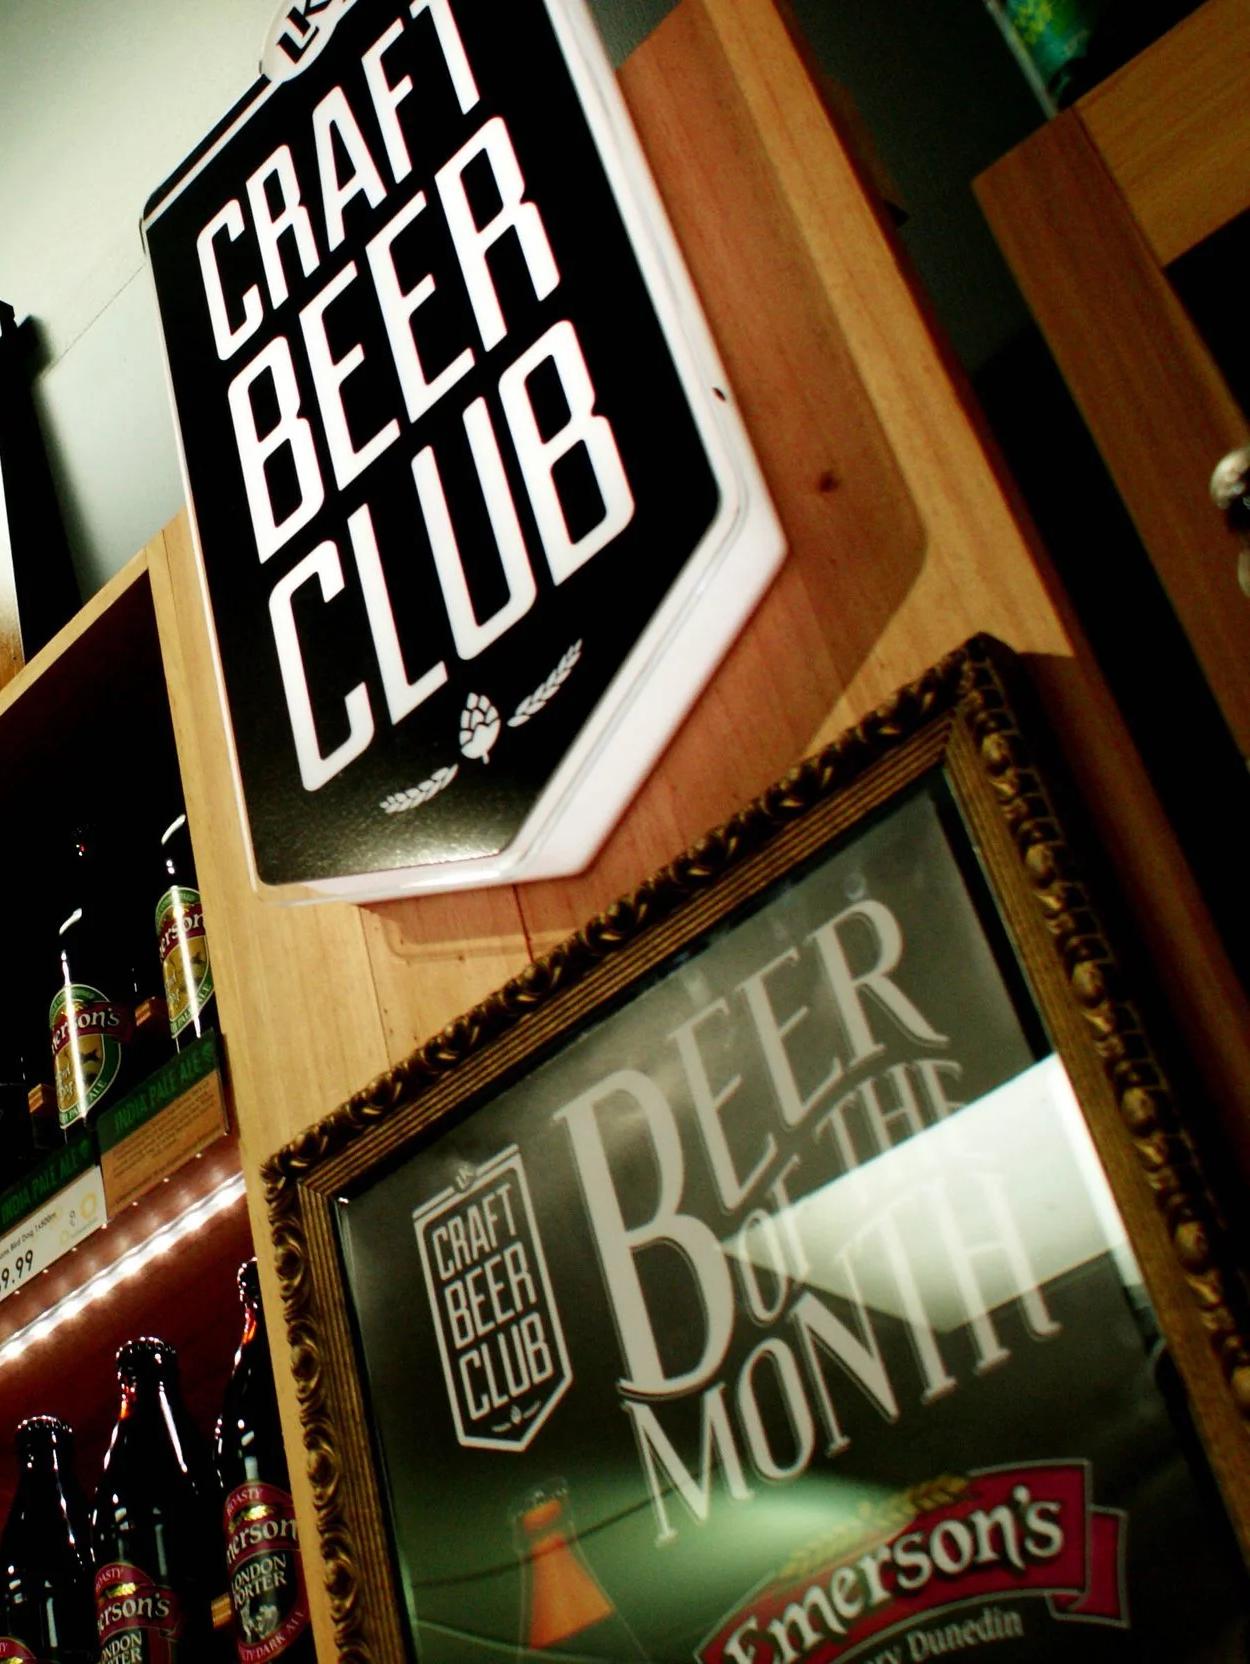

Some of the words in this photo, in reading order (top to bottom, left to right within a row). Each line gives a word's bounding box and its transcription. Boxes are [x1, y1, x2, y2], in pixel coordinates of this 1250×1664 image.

[196, 0, 480, 360] CRAFT
[228, 116, 560, 565] BEER
[268, 320, 636, 793] CLUB
[432, 1182, 517, 1281] CRAFT
[554, 898, 949, 1401] BEER
[736, 1153, 811, 1328] OF
[814, 1057, 995, 1206] THE
[444, 1241, 538, 1350] BEER
[459, 1311, 554, 1421] CLUB
[620, 1171, 1062, 1548] MONTH
[723, 1484, 1065, 1664] Emerson's
[907, 1606, 1024, 1661] Dunedin
